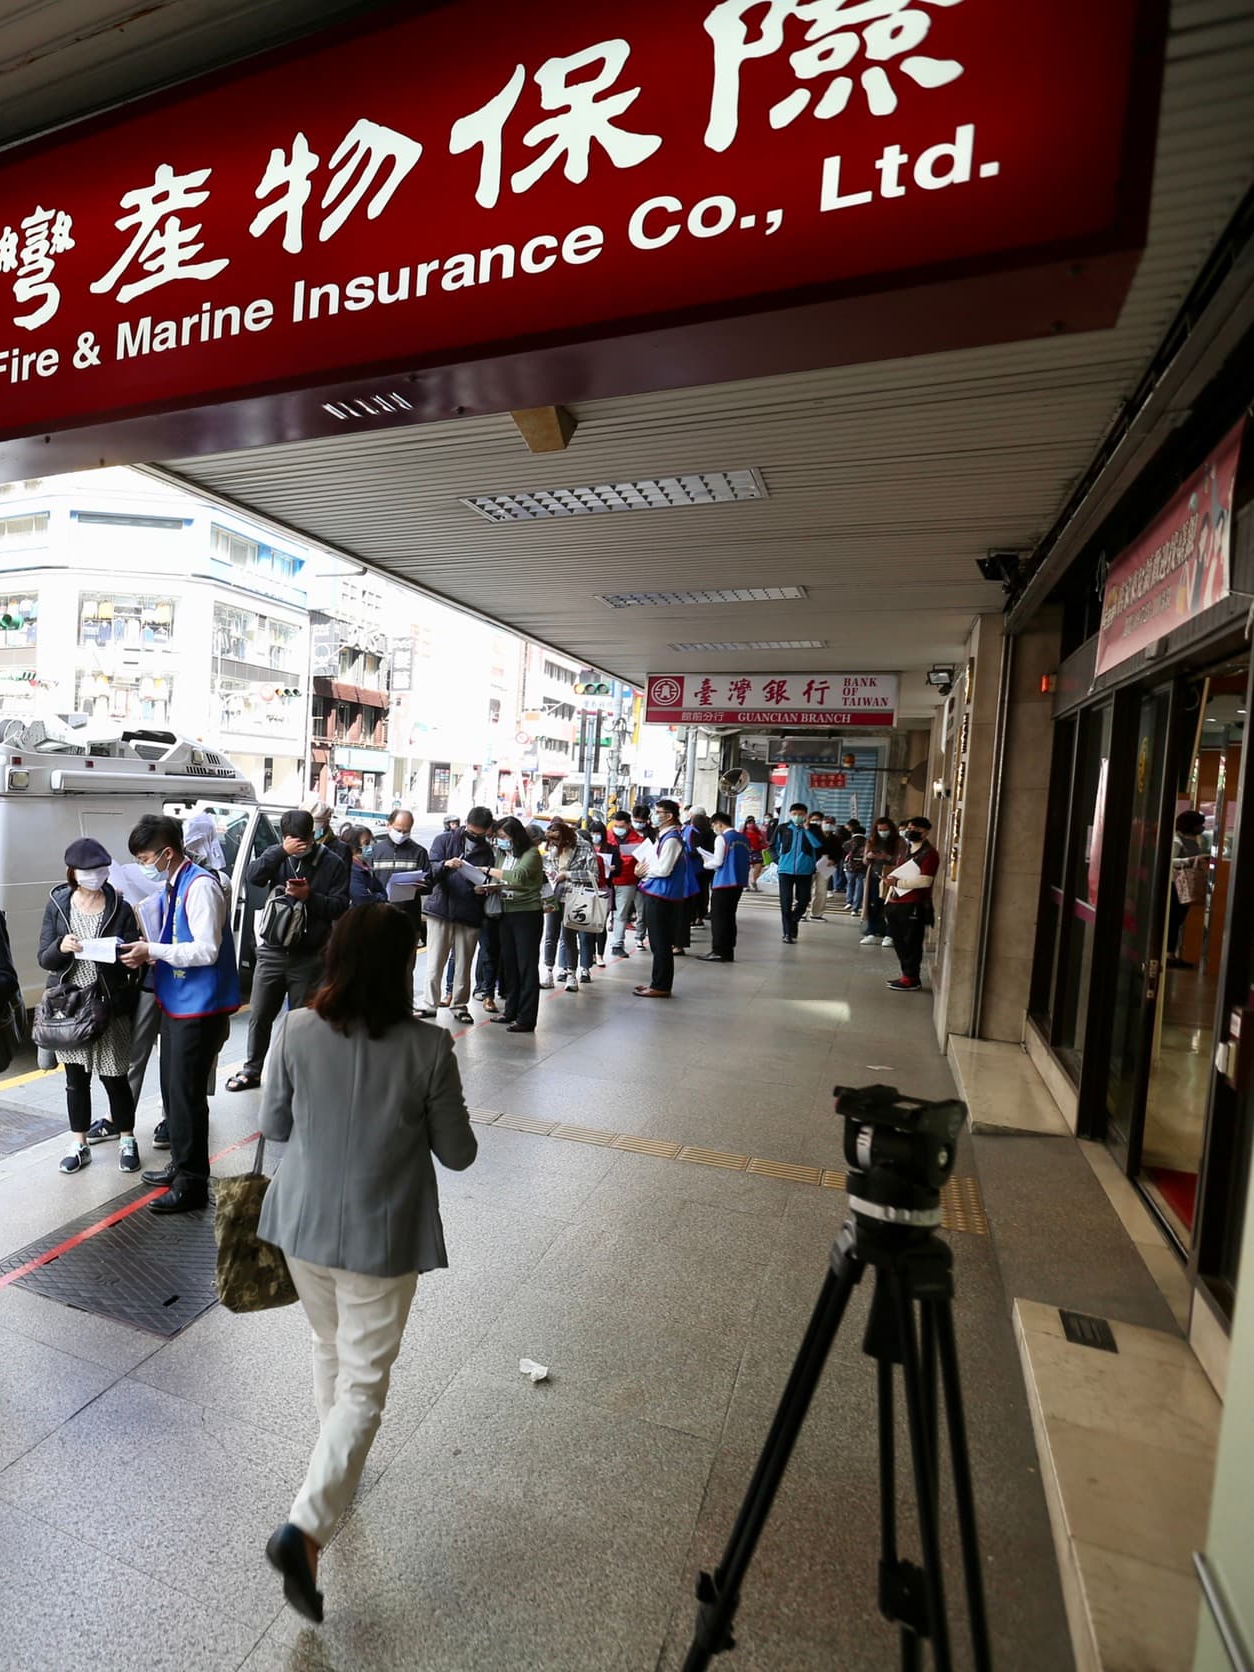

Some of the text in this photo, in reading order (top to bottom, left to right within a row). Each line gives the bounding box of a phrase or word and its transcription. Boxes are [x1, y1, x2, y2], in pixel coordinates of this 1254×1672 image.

[73, 332, 102, 370] &
[116, 299, 275, 361] Marine
[292, 225, 605, 324] Insurance
[628, 195, 784, 251] Co.,
[820, 124, 1001, 213] Ltd.
[843, 677, 878, 687] BANK
[694, 678, 830, 706] 臺灣銀行
[842, 687, 858, 696] OF
[842, 697, 889, 707] TAIWAN
[681, 711, 724, 722] 館前分行
[738, 712, 851, 723] GUANCIAN BRANCH
